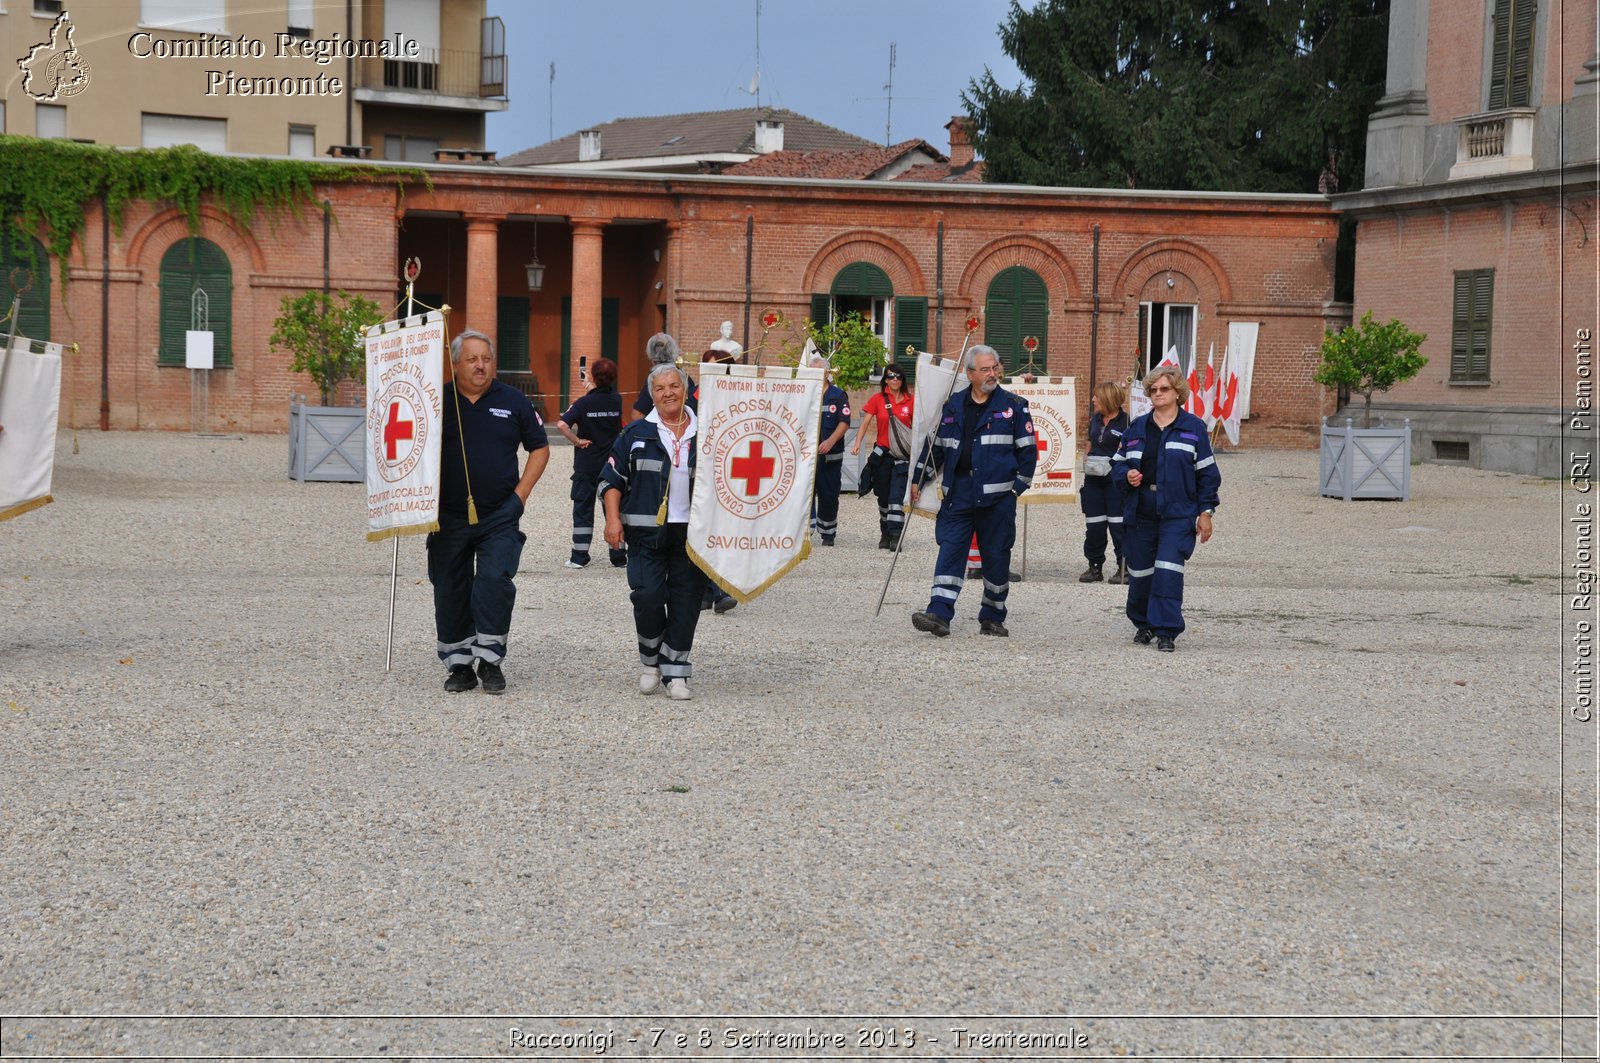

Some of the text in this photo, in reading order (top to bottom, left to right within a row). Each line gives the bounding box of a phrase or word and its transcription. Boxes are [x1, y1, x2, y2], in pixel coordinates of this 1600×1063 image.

[380, 362, 409, 385] ROSSA
[409, 363, 440, 418] ITALIANA
[716, 380, 753, 392] VOLONTARI
[756, 382, 768, 393] DEL
[702, 399, 811, 461] CROCE ROSSA ITALIANA
[728, 428, 740, 440] DI
[744, 421, 781, 441] GINEVRA
[1043, 405, 1072, 438] ITALIANA
[413, 416, 425, 456] AGOSTO
[780, 441, 791, 454] 22
[714, 440, 743, 513] CONVENZIONE
[777, 457, 794, 496] AGOSTO
[391, 487, 423, 499] LOCALE
[424, 486, 433, 496] DI
[706, 535, 794, 550] SAVIGLIANO
